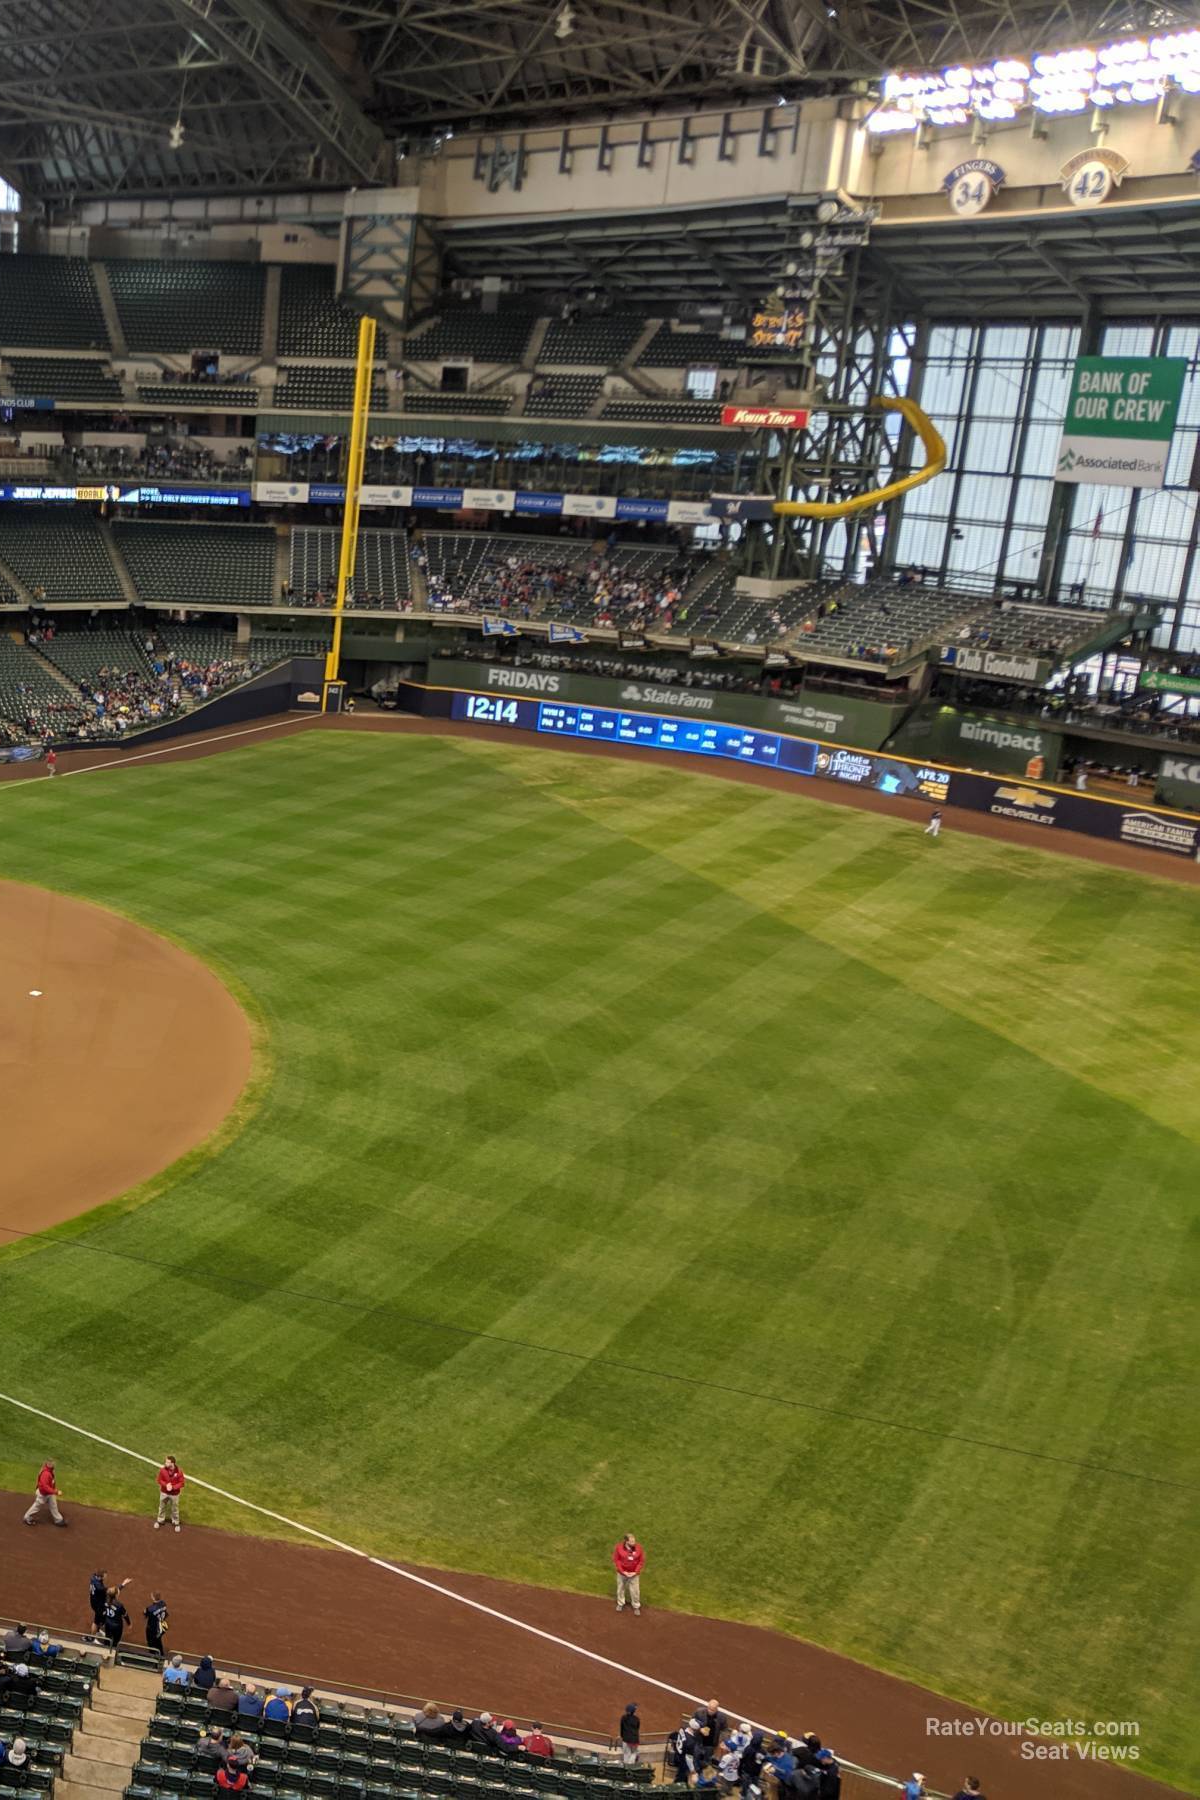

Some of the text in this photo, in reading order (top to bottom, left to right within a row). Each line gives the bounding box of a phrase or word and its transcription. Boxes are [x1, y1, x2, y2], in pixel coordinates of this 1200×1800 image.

[954, 160, 996, 177] FINGERS
[956, 180, 985, 207] 34
[1074, 170, 1105, 197] 42
[1078, 371, 1152, 395] BANK OF
[16, 398, 35, 408] CLUB
[1074, 397, 1165, 422] OUR CREW
[1075, 455, 1164, 472] Associated Bank
[163, 494, 179, 502] ONLY
[180, 495, 210, 504] MIDWEST
[955, 647, 1039, 681] Club Goodwill
[488, 668, 560, 693] FRIDAYS
[466, 696, 519, 723] 12:14
[973, 722, 1043, 752] impact
[832, 759, 871, 776] THRONES
[836, 751, 863, 765] GAME
[837, 771, 863, 782] NIGHT
[937, 773, 950, 784] 20
[990, 804, 1056, 825] CHEVROLET
[1124, 818, 1195, 839] AMERICAN FAMILY
